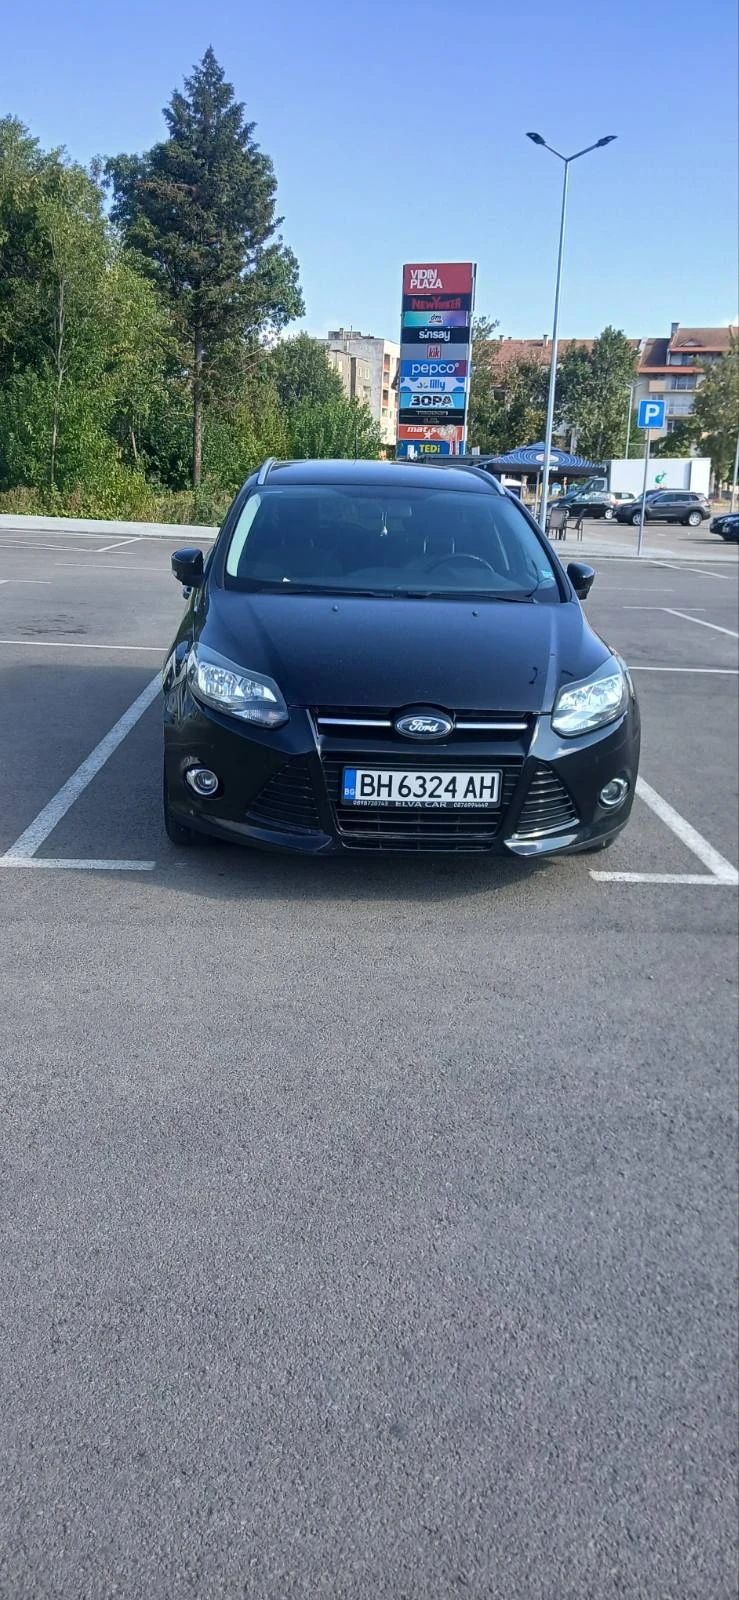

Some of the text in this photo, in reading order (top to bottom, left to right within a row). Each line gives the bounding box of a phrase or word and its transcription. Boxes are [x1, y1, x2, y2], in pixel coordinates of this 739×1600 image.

[410, 269, 438, 279] VIDIN
[410, 279, 443, 289] PLAZA
[418, 329, 451, 341] sinsay
[429, 379, 446, 391] lilly
[645, 404, 660, 424] P
[419, 444, 440, 454] TEDi
[409, 719, 438, 733] Ford
[344, 788, 355, 796] BG
[360, 773, 496, 799] BH 6324 AH
